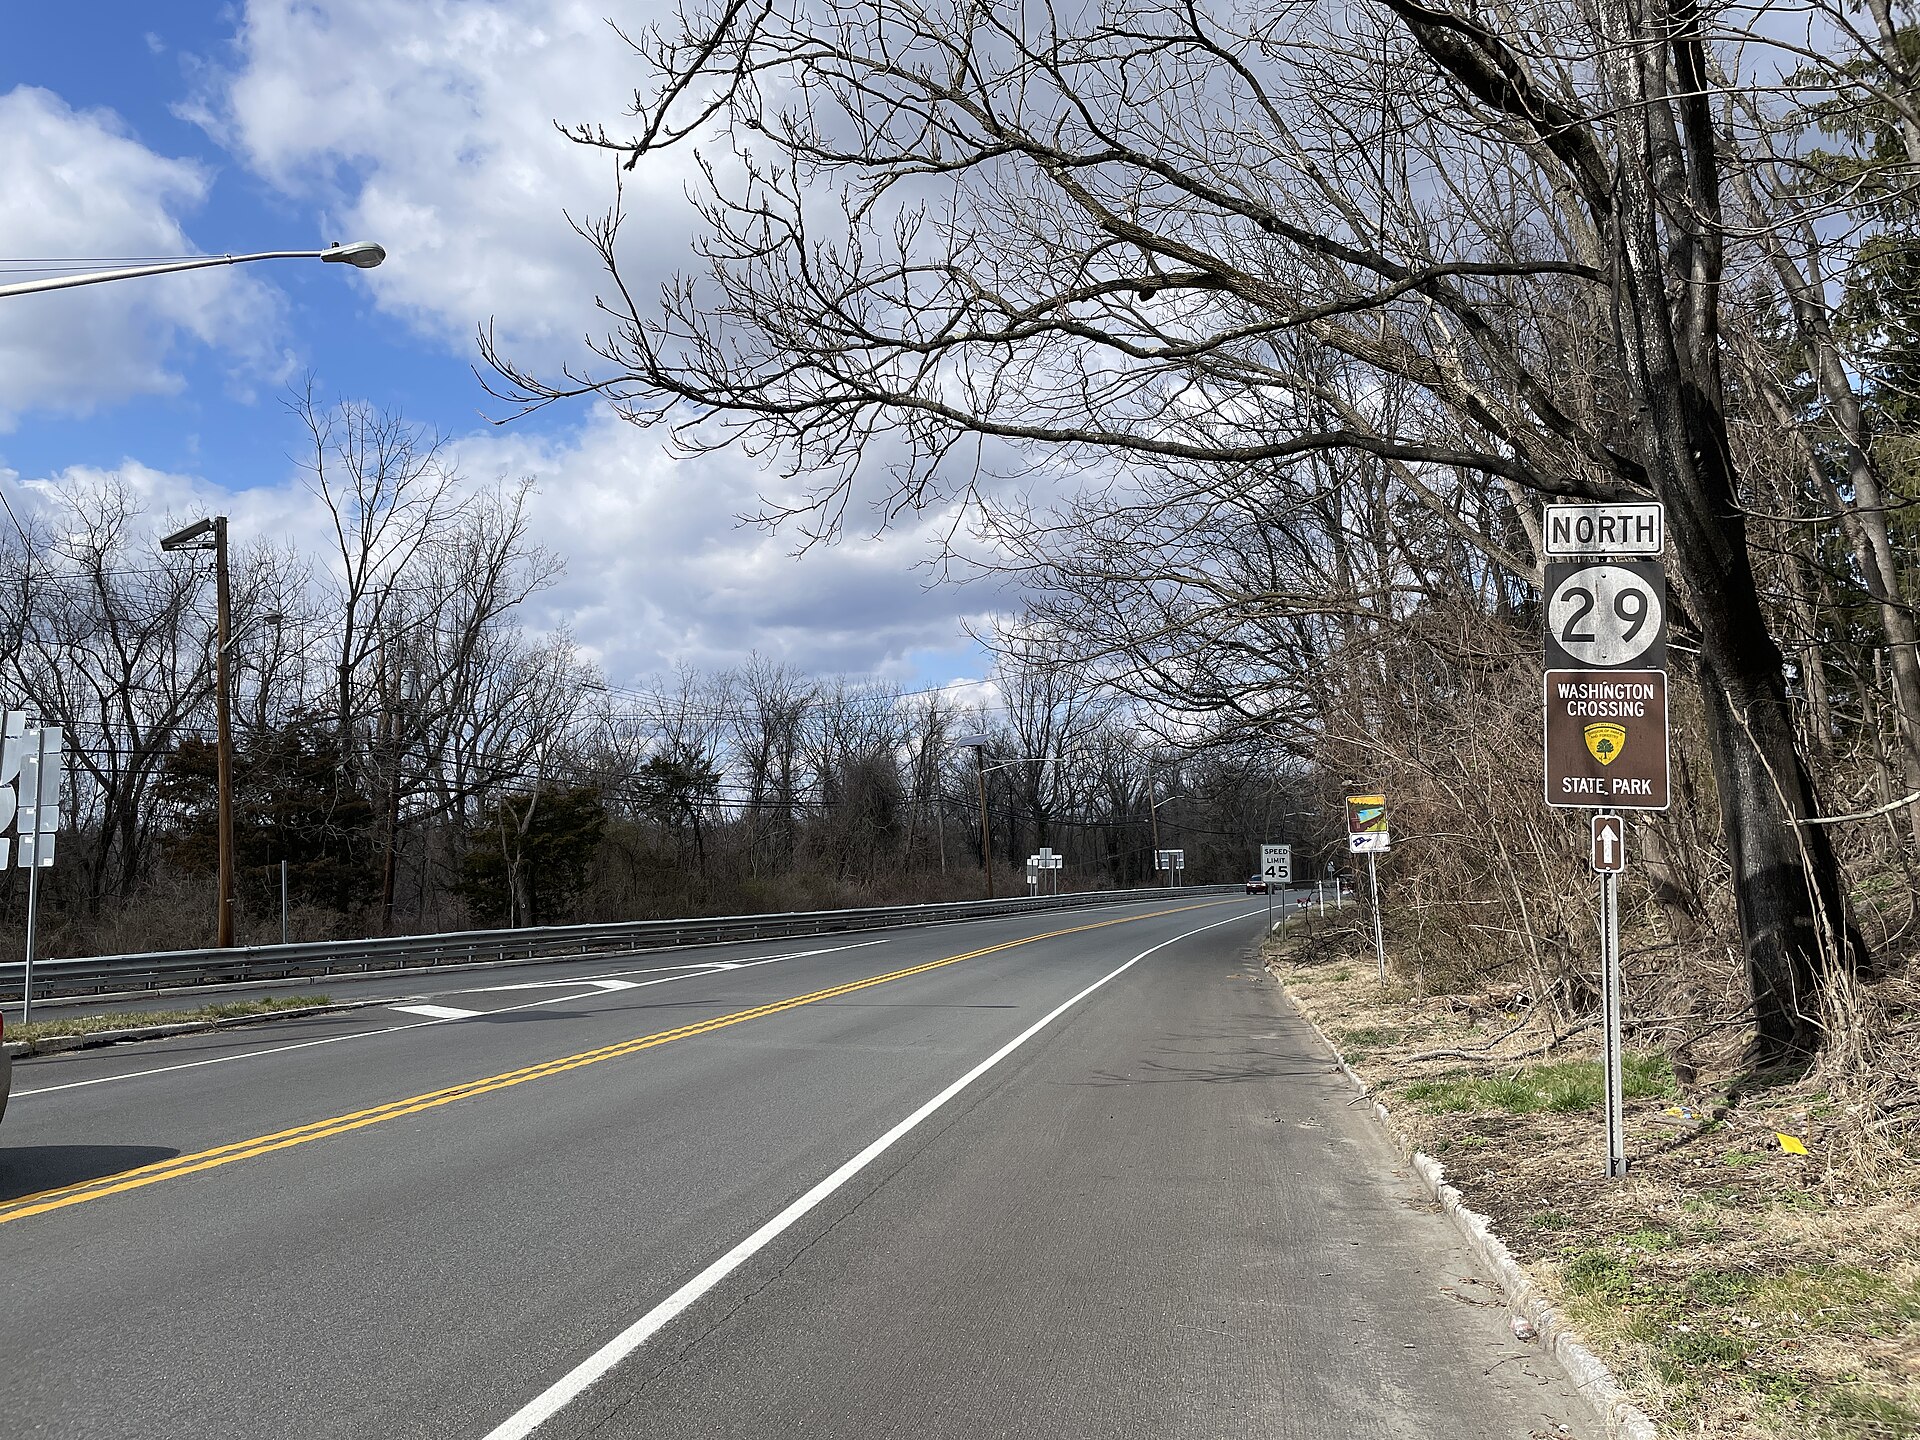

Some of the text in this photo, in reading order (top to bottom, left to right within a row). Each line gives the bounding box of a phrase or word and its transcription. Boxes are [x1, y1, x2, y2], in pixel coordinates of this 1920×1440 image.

[1552, 515, 1654, 543] NORTH
[1561, 587, 1648, 643] 29
[1558, 683, 1654, 699] WASHINGTON
[1567, 700, 1645, 717] CROSSING
[1562, 777, 1652, 795] STATE PARK
[1264, 865, 1288, 878] 45
